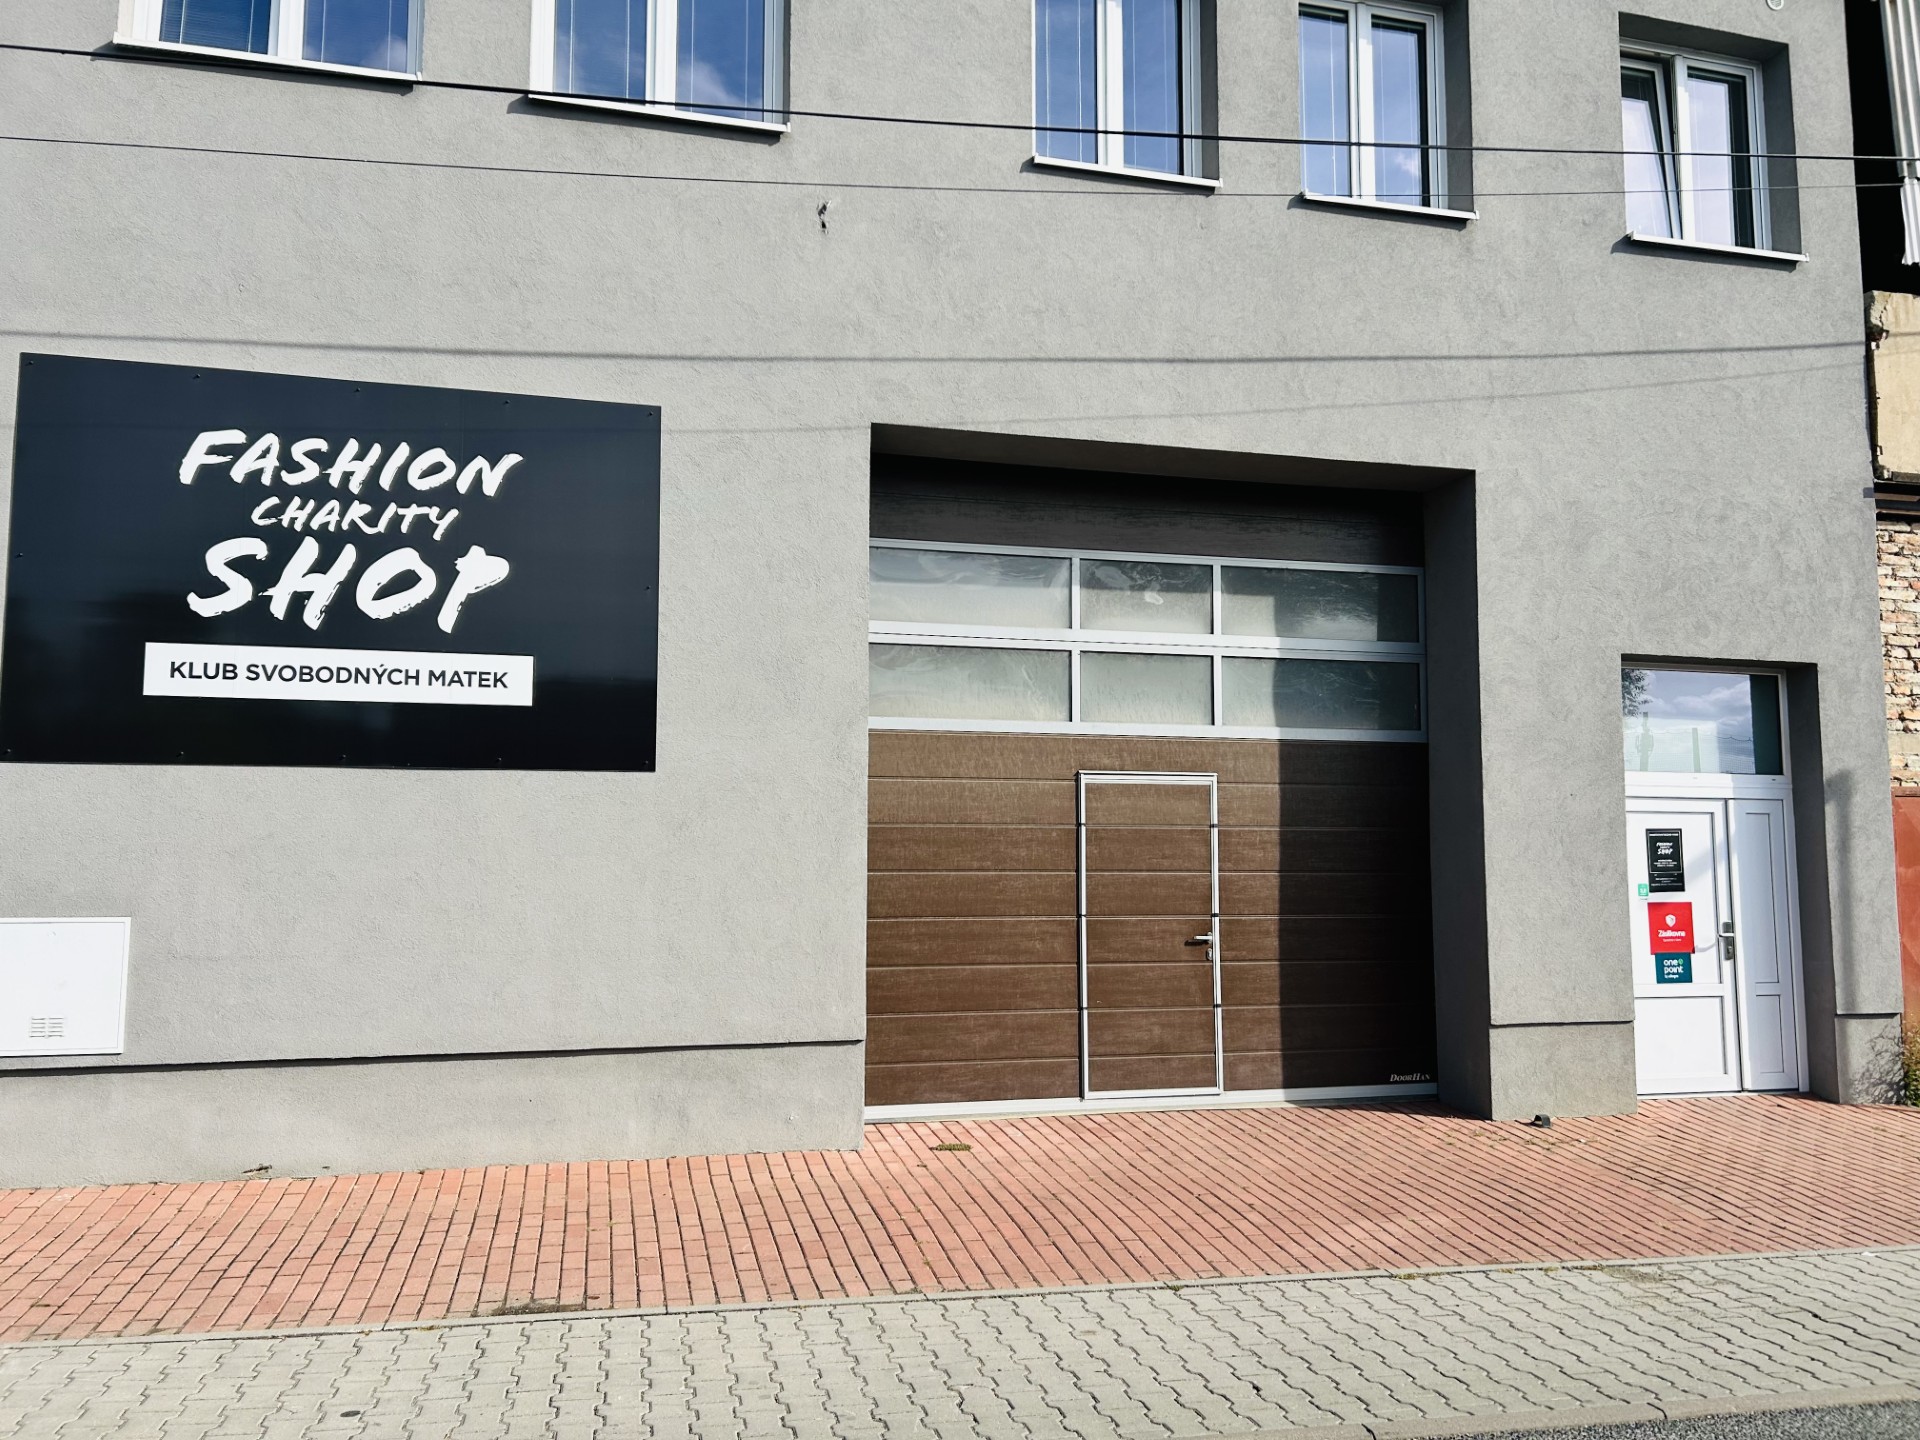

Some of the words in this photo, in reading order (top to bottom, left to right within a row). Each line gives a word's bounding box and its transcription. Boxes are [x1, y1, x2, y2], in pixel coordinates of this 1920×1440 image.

[178, 428, 524, 497] FASHION
[250, 495, 460, 541] CHARITY
[186, 535, 510, 634] SHOP
[170, 661, 238, 680] KLUB
[245, 663, 420, 687] SVOBODNÝCH
[428, 669, 508, 690] MATEK
[1663, 966, 1684, 974] point
